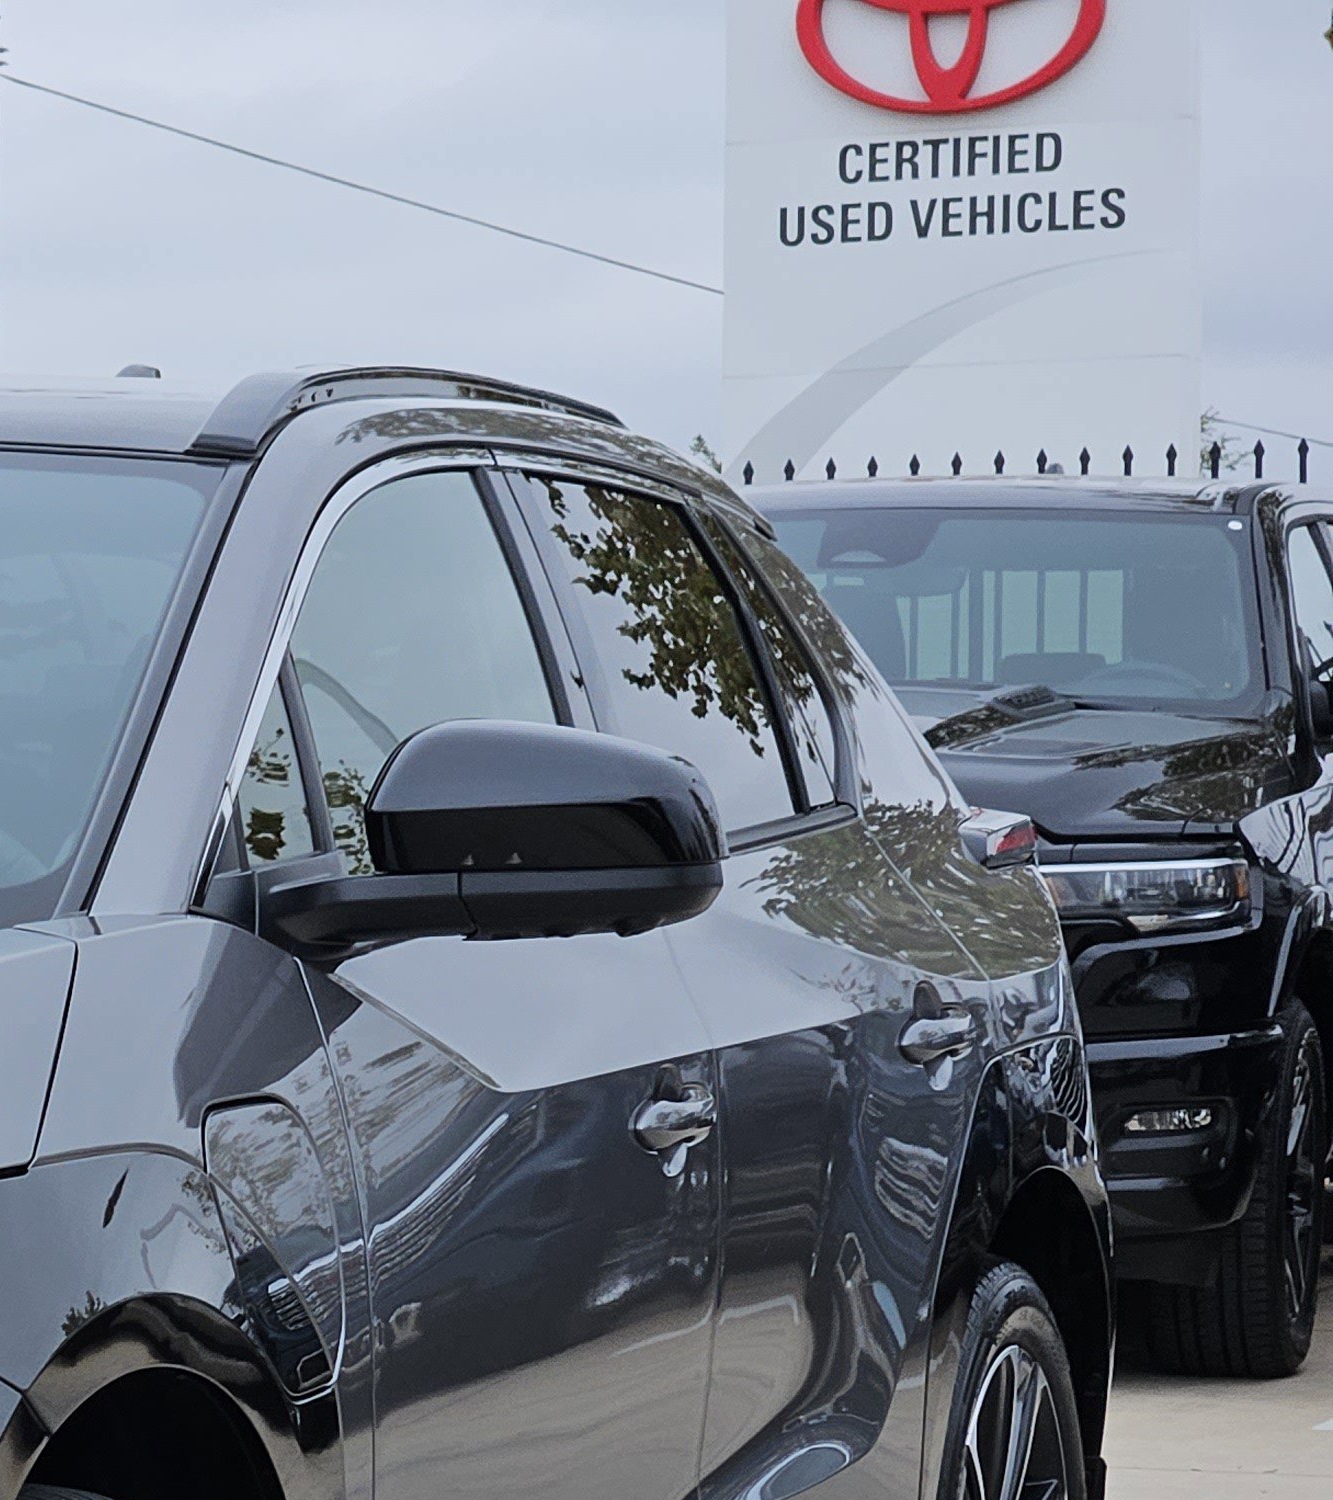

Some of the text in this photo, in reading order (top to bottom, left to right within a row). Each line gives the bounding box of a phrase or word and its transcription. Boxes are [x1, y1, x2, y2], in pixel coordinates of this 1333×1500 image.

[838, 131, 1063, 184] CERTIFIED
[778, 187, 1126, 247] USED VEHICLES
